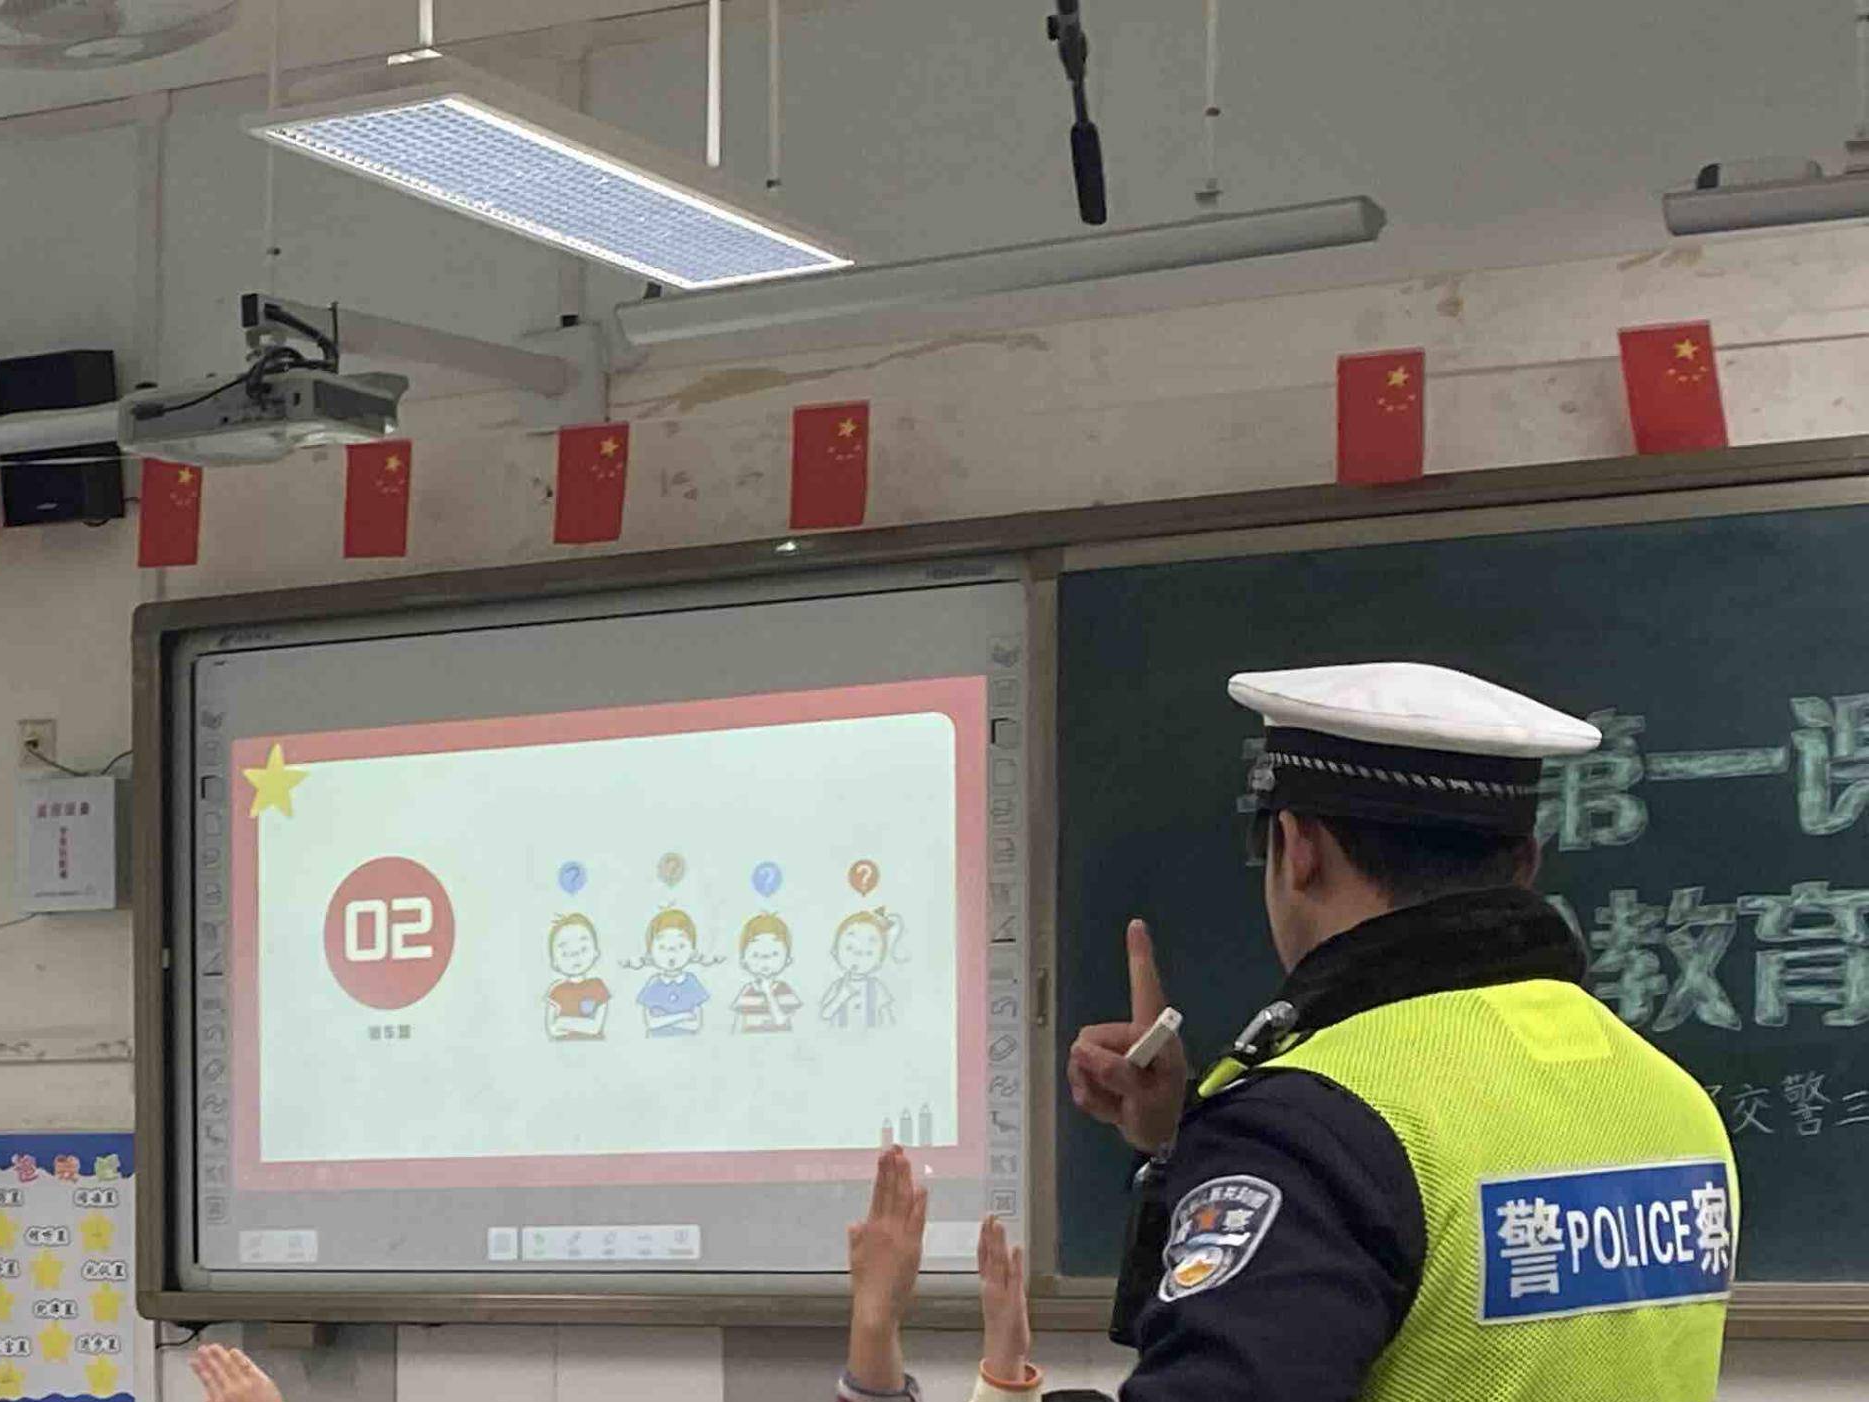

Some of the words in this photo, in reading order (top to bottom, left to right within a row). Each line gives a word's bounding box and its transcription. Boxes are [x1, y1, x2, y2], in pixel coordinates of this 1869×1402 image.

[345, 896, 433, 961] 02
[1547, 880, 1869, 1032] 教育
[1707, 1070, 1869, 1136] 交警三
